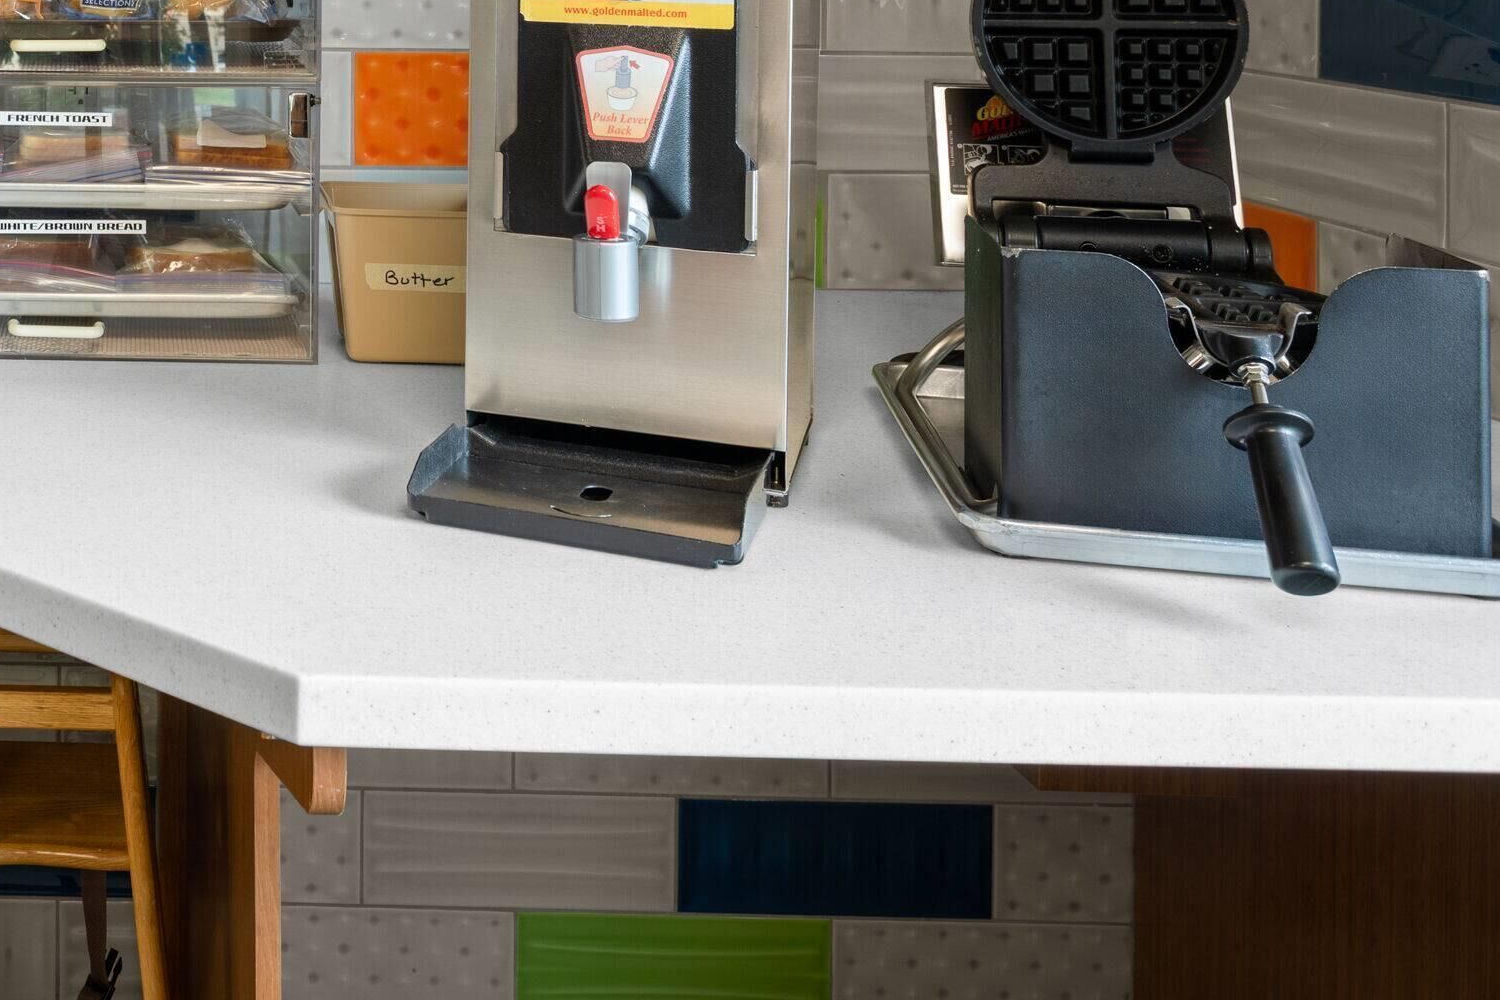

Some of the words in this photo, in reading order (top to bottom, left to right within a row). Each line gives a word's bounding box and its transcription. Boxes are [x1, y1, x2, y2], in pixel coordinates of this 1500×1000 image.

[564, 6, 688, 19] www.goldenmalted.com
[7, 114, 60, 123] FRENCH
[62, 114, 108, 123] TOAST
[592, 111, 617, 122] Push
[620, 113, 649, 125] Lever
[607, 125, 632, 136] Back
[97, 222, 143, 231] BREAD
[385, 270, 455, 288] Butter
